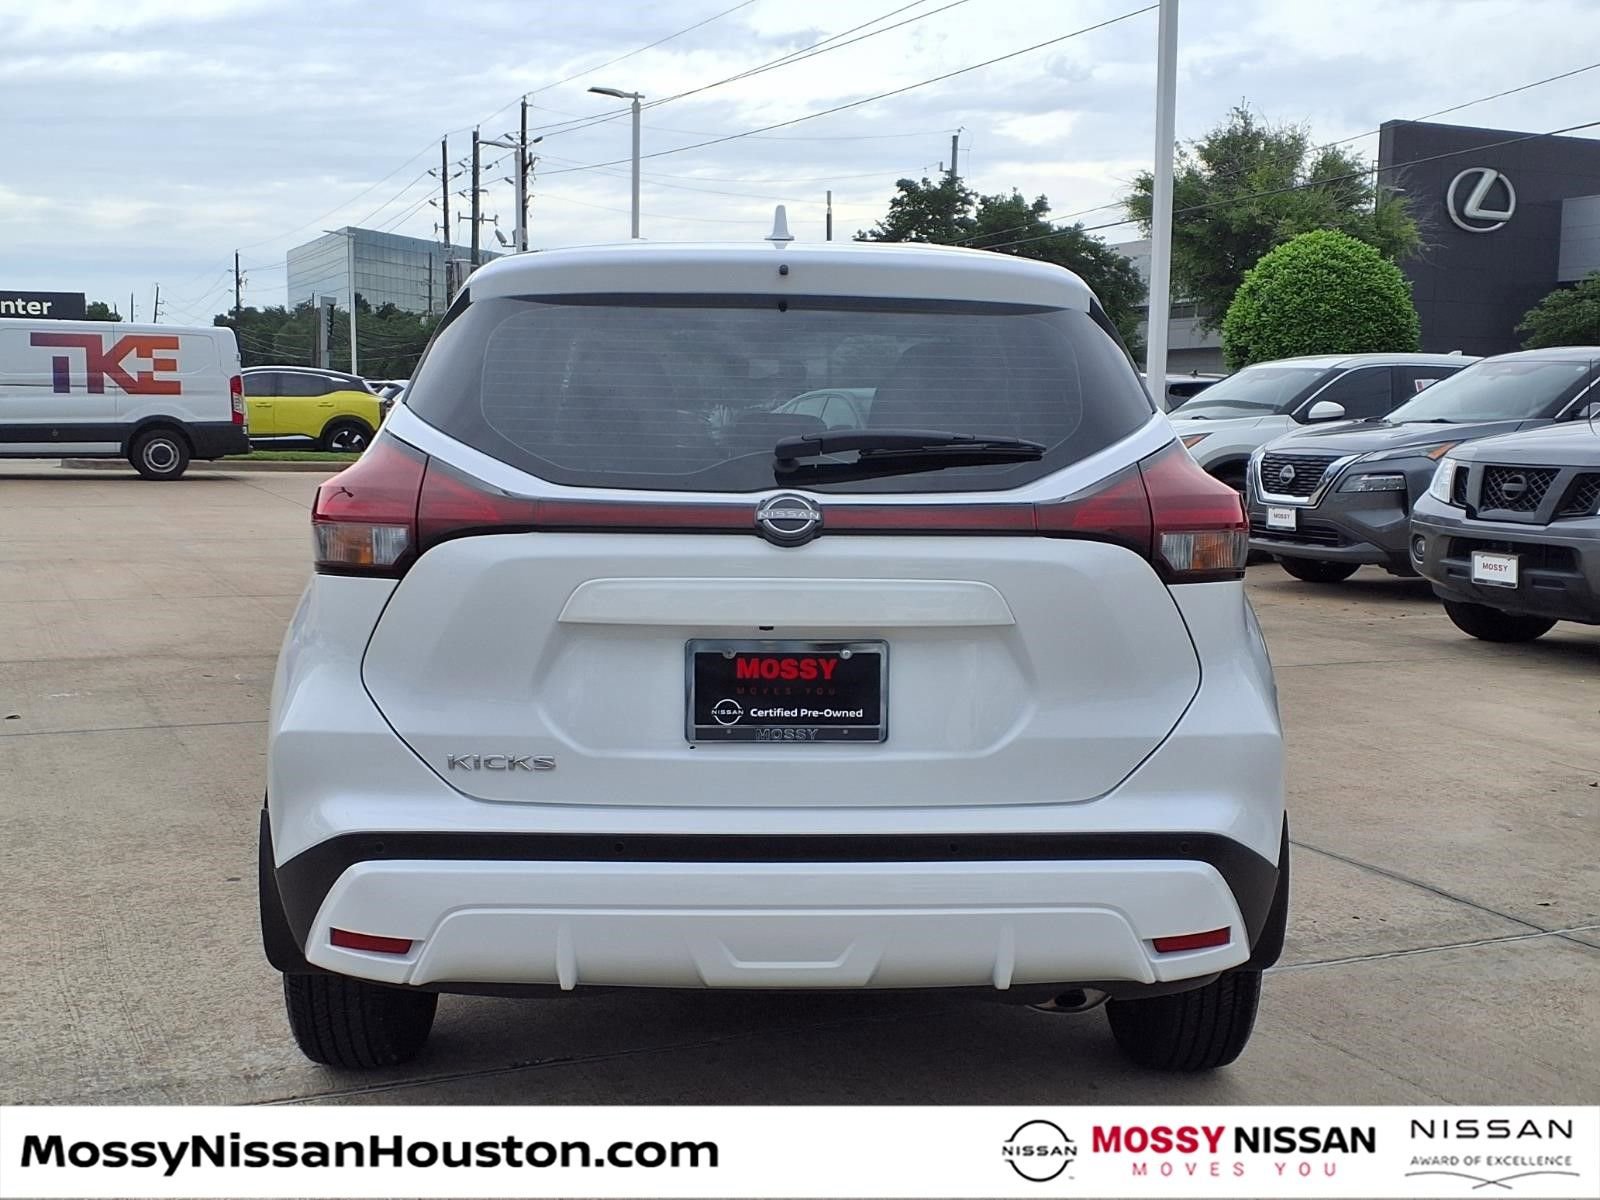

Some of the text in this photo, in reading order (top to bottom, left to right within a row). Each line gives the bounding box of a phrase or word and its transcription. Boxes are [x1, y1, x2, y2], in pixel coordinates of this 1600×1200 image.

[0, 298, 52, 315] nter
[30, 332, 182, 395] TKE
[758, 510, 820, 519] NISSAN
[1482, 561, 1509, 572] MOSSY
[736, 657, 838, 680] MOSSY
[750, 707, 863, 718] Certified Pre-Owned
[755, 728, 819, 741] MOSSY
[447, 753, 556, 771] KICKS
